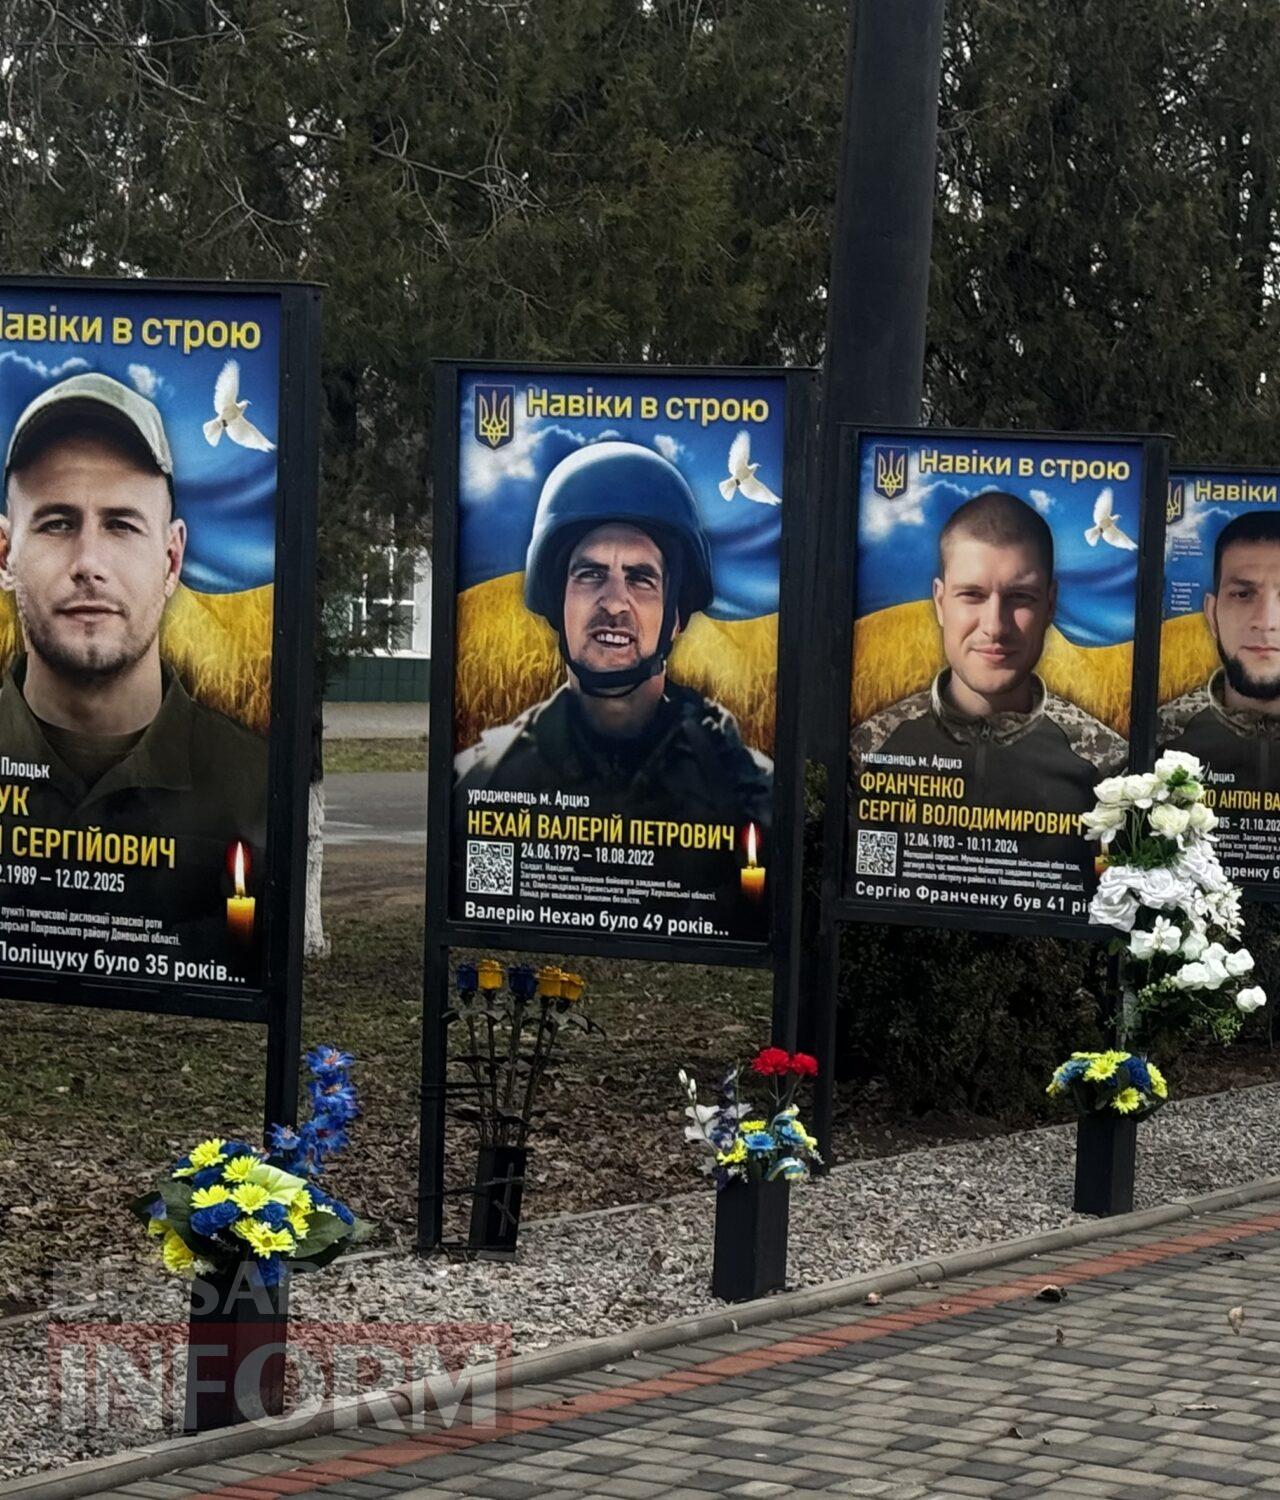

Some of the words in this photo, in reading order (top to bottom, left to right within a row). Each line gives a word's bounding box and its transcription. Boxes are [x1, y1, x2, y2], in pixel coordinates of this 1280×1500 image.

[0, 305, 102, 343] авіки
[112, 316, 133, 344] в
[141, 318, 261, 354] строю
[526, 387, 632, 419] Навіки
[641, 396, 658, 419] в
[665, 397, 769, 426] строю
[919, 449, 1011, 475] Навіки
[1018, 458, 1033, 476] в
[1040, 458, 1130, 483] строю
[1195, 479, 1277, 502] Навіки
[1, 756, 50, 780] Плоцьк
[861, 753, 916, 768] мешканець
[919, 757, 929, 767] м.
[931, 754, 963, 770] Арциз
[860, 770, 964, 799] ФРАНЧЕНКО
[1207, 770, 1235, 784] Арциз
[468, 788, 537, 806] уродженець
[540, 793, 552, 805] м.
[555, 790, 590, 808] Арциз
[1219, 789, 1261, 811] АНТОН
[468, 808, 530, 839] НЕХАЙ
[538, 813, 623, 844] ВАЛЕРІЙ
[629, 819, 735, 851] ПЕТРОВИЧ
[859, 797, 917, 825] СЕРГІЙ
[922, 806, 1083, 836] ВОЛОДИМИРОВИЧ
[12, 826, 176, 869] СЕРГІЙОВИЧ
[521, 843, 580, 862] 24.06.1973
[596, 847, 654, 867] 18.08.2022
[904, 832, 955, 849] 12.04.1983
[967, 837, 1018, 854] 10.11.2024
[55, 868, 125, 893] 12.02.2025
[1224, 865, 1269, 883] аренку
[856, 880, 910, 900] Сергію
[916, 885, 1008, 908] Франченку
[1014, 892, 1041, 912] був
[1047, 896, 1065, 911] 41
[1072, 898, 1089, 915] рі
[465, 901, 535, 925] Валерію
[540, 906, 595, 928] Нехаю
[599, 909, 639, 932] було
[643, 913, 663, 931] 49
[667, 916, 729, 936] років...
[94, 949, 140, 976] було
[145, 954, 169, 975] 35
[174, 960, 246, 983] років...
